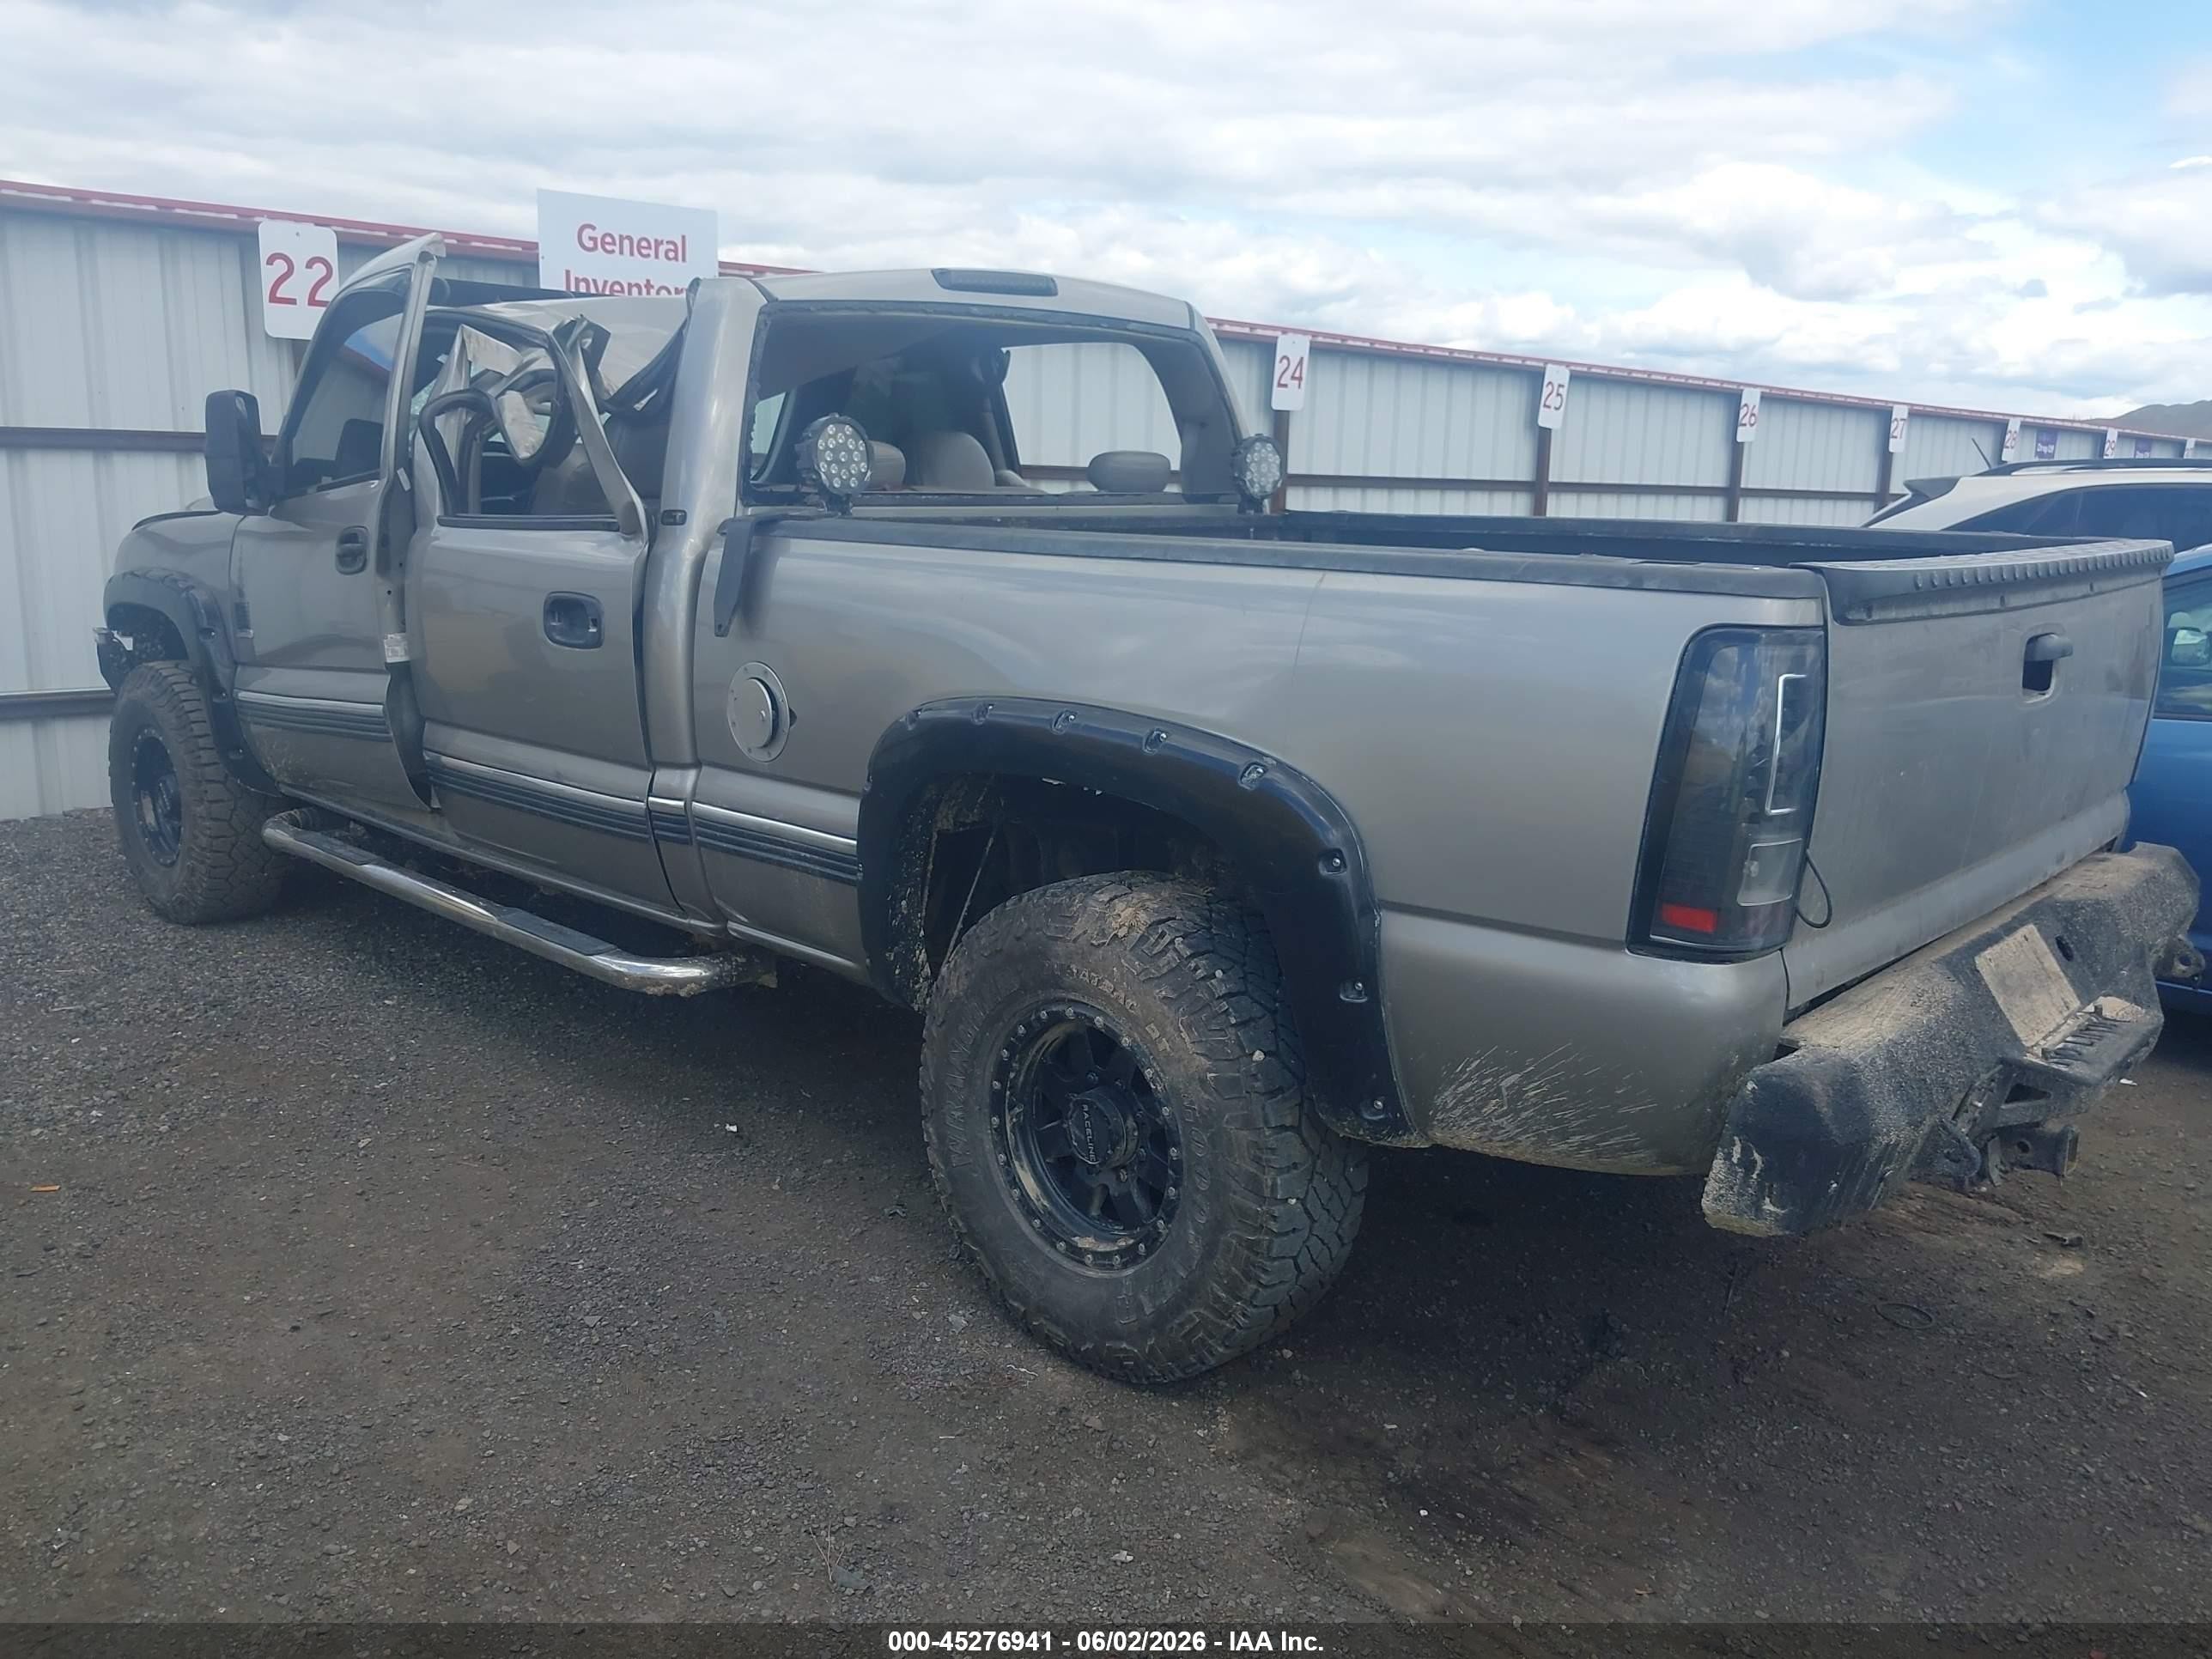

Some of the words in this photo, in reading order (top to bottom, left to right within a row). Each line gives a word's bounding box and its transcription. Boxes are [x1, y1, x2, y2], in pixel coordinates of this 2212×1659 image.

[577, 223, 687, 263] General
[265, 252, 333, 308] 22
[1277, 356, 1304, 389] 24
[1543, 381, 1565, 410] 25
[1740, 404, 1757, 427] 26
[1890, 418, 1906, 439] 27
[1082, 1104, 1097, 1162] RACELINE
